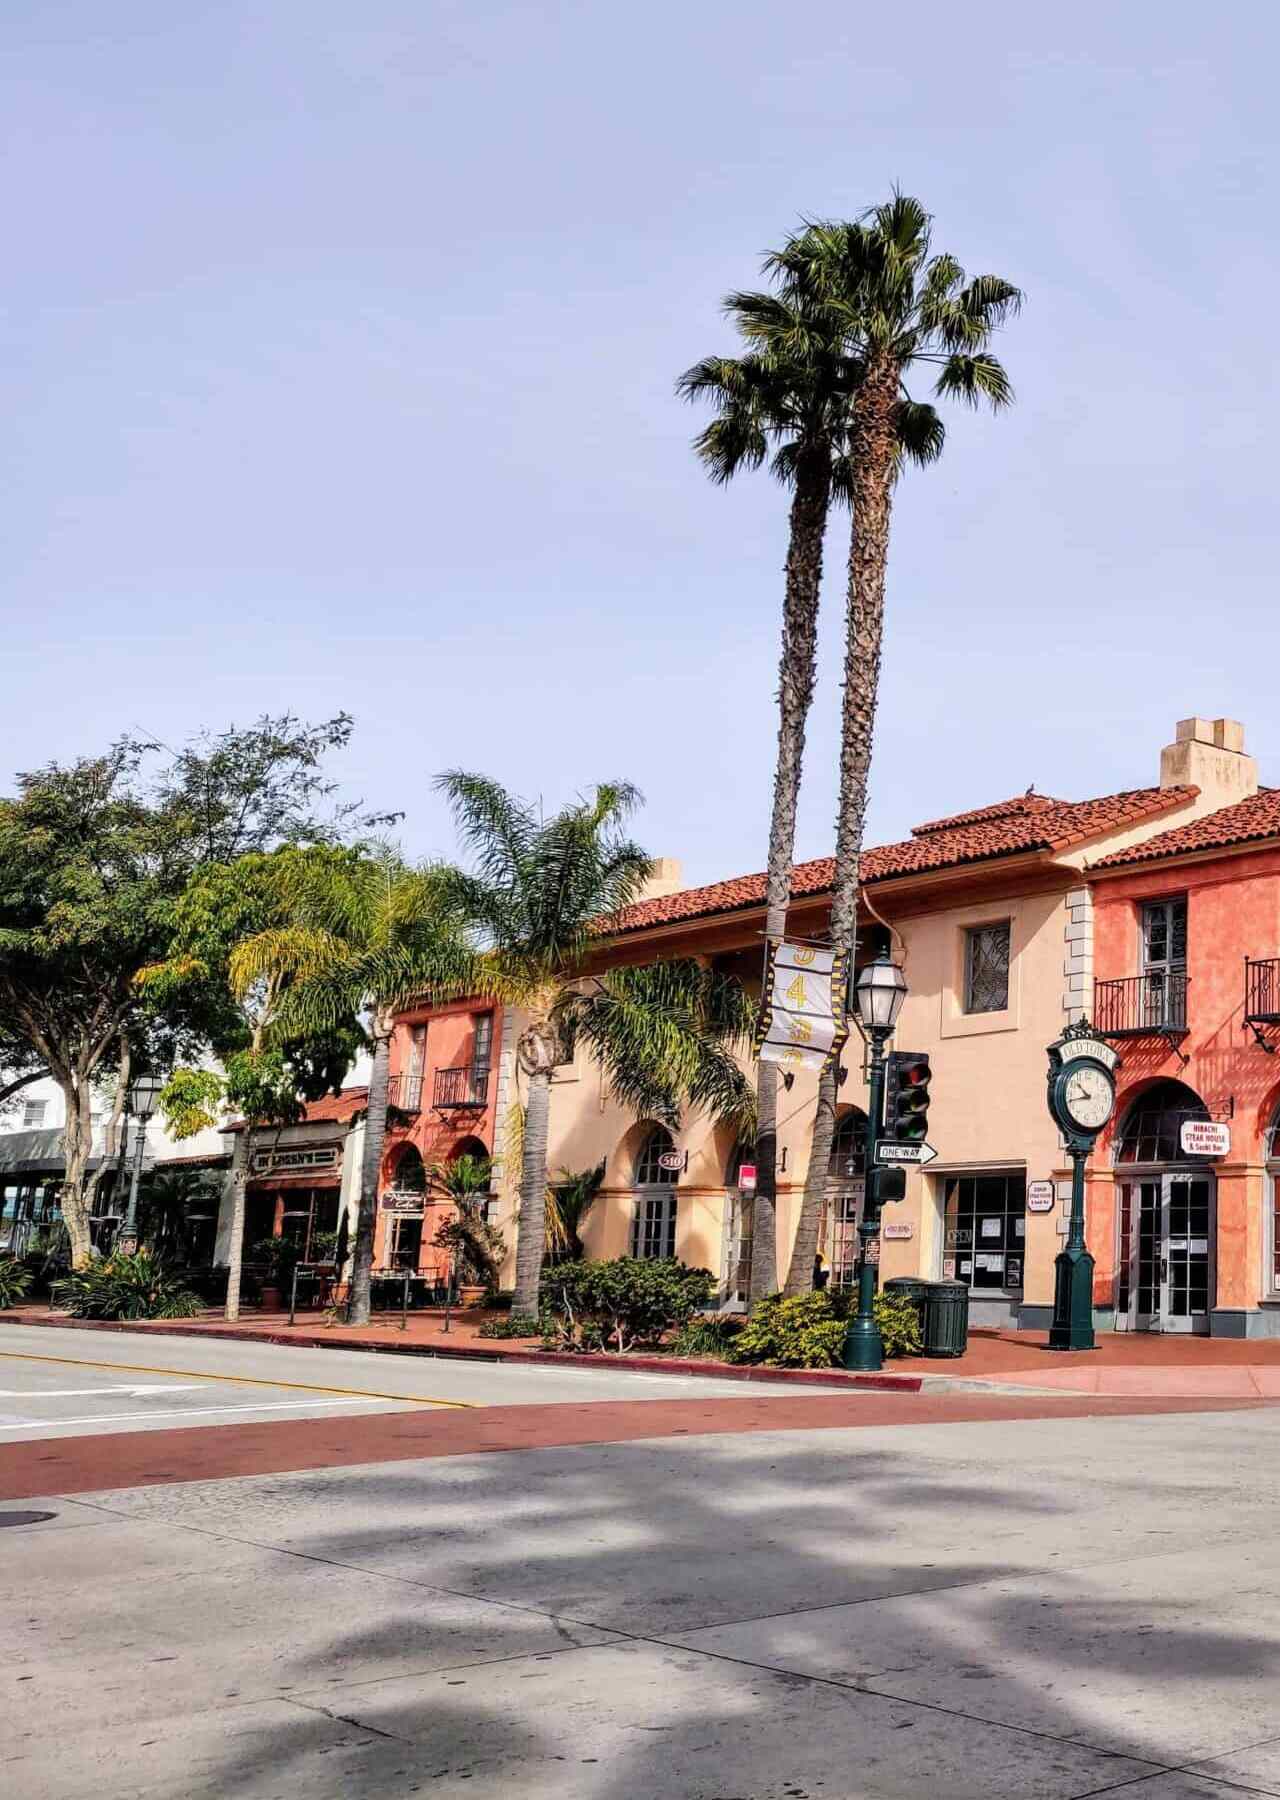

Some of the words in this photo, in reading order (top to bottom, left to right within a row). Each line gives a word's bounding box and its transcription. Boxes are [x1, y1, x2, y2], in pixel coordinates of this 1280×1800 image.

[786, 973, 808, 1008] 4
[1185, 1133, 1203, 1142] STEAK
[1205, 1135, 1225, 1143] HOUSE
[881, 1147, 901, 1157] ONE
[903, 1148, 920, 1157] WAY
[663, 1155, 681, 1167] 510
[947, 1229, 972, 1243] OPEN
